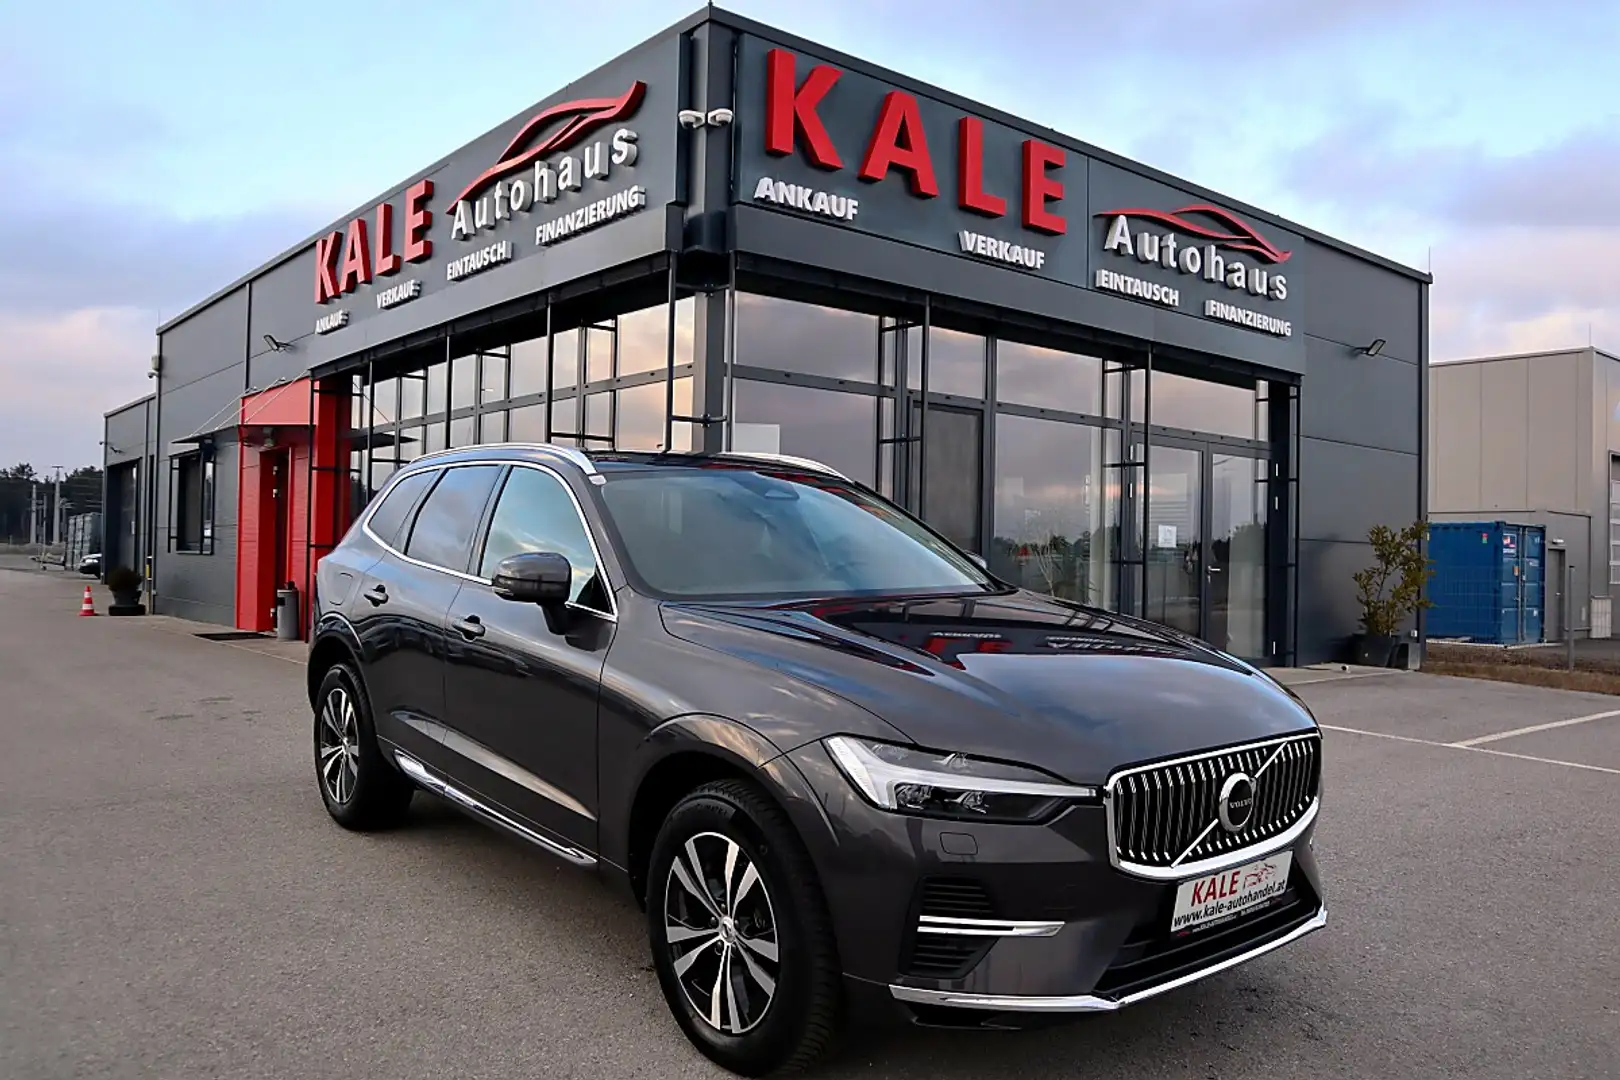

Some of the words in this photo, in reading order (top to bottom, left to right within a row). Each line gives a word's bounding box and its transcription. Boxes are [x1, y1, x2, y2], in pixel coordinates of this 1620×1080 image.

[766, 48, 1066, 235] KALE
[451, 128, 638, 241] Autohaus
[754, 177, 858, 220] ANKAUF
[535, 186, 645, 246] FINANZIERUNG
[314, 179, 434, 304] KALE
[446, 240, 513, 281] EINTAUSCH
[958, 230, 1045, 270] VERKAUF
[1104, 214, 1287, 300] Autohaus
[376, 280, 421, 309] VERKAUF
[1096, 269, 1179, 307] EINTAUSCH
[315, 310, 349, 334] ANKAUF
[1205, 300, 1292, 337] FINANZIERUNG
[1174, 879, 1285, 927] www.kale-autohandel.at
[1190, 870, 1241, 907] KALE
